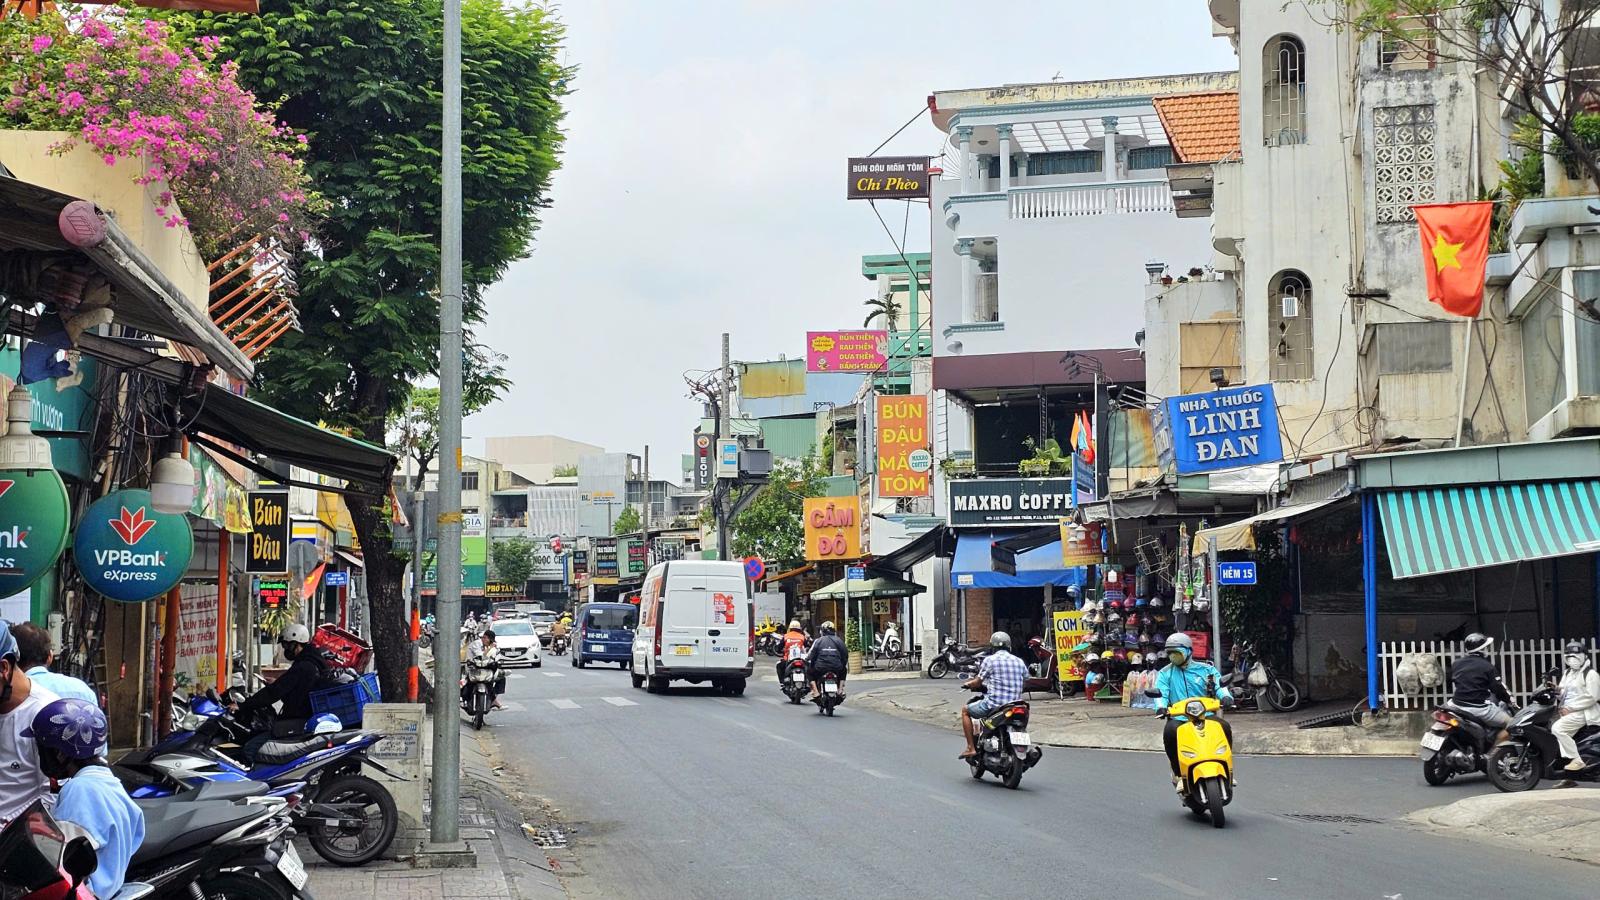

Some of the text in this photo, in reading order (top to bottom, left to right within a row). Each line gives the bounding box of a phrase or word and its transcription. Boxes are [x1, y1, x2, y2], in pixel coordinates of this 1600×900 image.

[852, 163, 868, 173] BÚN
[869, 163, 885, 174] ĐẬU
[907, 162, 924, 172] TÔM
[857, 177, 919, 191] Chí Phèo
[882, 400, 922, 419] BÚN
[1180, 389, 1263, 413] NHÀ THUỐC
[1187, 407, 1262, 437] LINH
[882, 424, 923, 447] ĐẬU
[1196, 434, 1259, 462] ĐAN
[880, 449, 909, 471] MẮ
[882, 473, 925, 492] TÔM
[954, 493, 1074, 511] MAXRO COFFE
[254, 498, 282, 526] Bún
[94, 549, 165, 567] VPBank
[253, 532, 280, 566] Đậu
[103, 569, 158, 583] eXpress
[1222, 566, 1253, 579] HẺM 15
[873, 601, 889, 612] 3%
